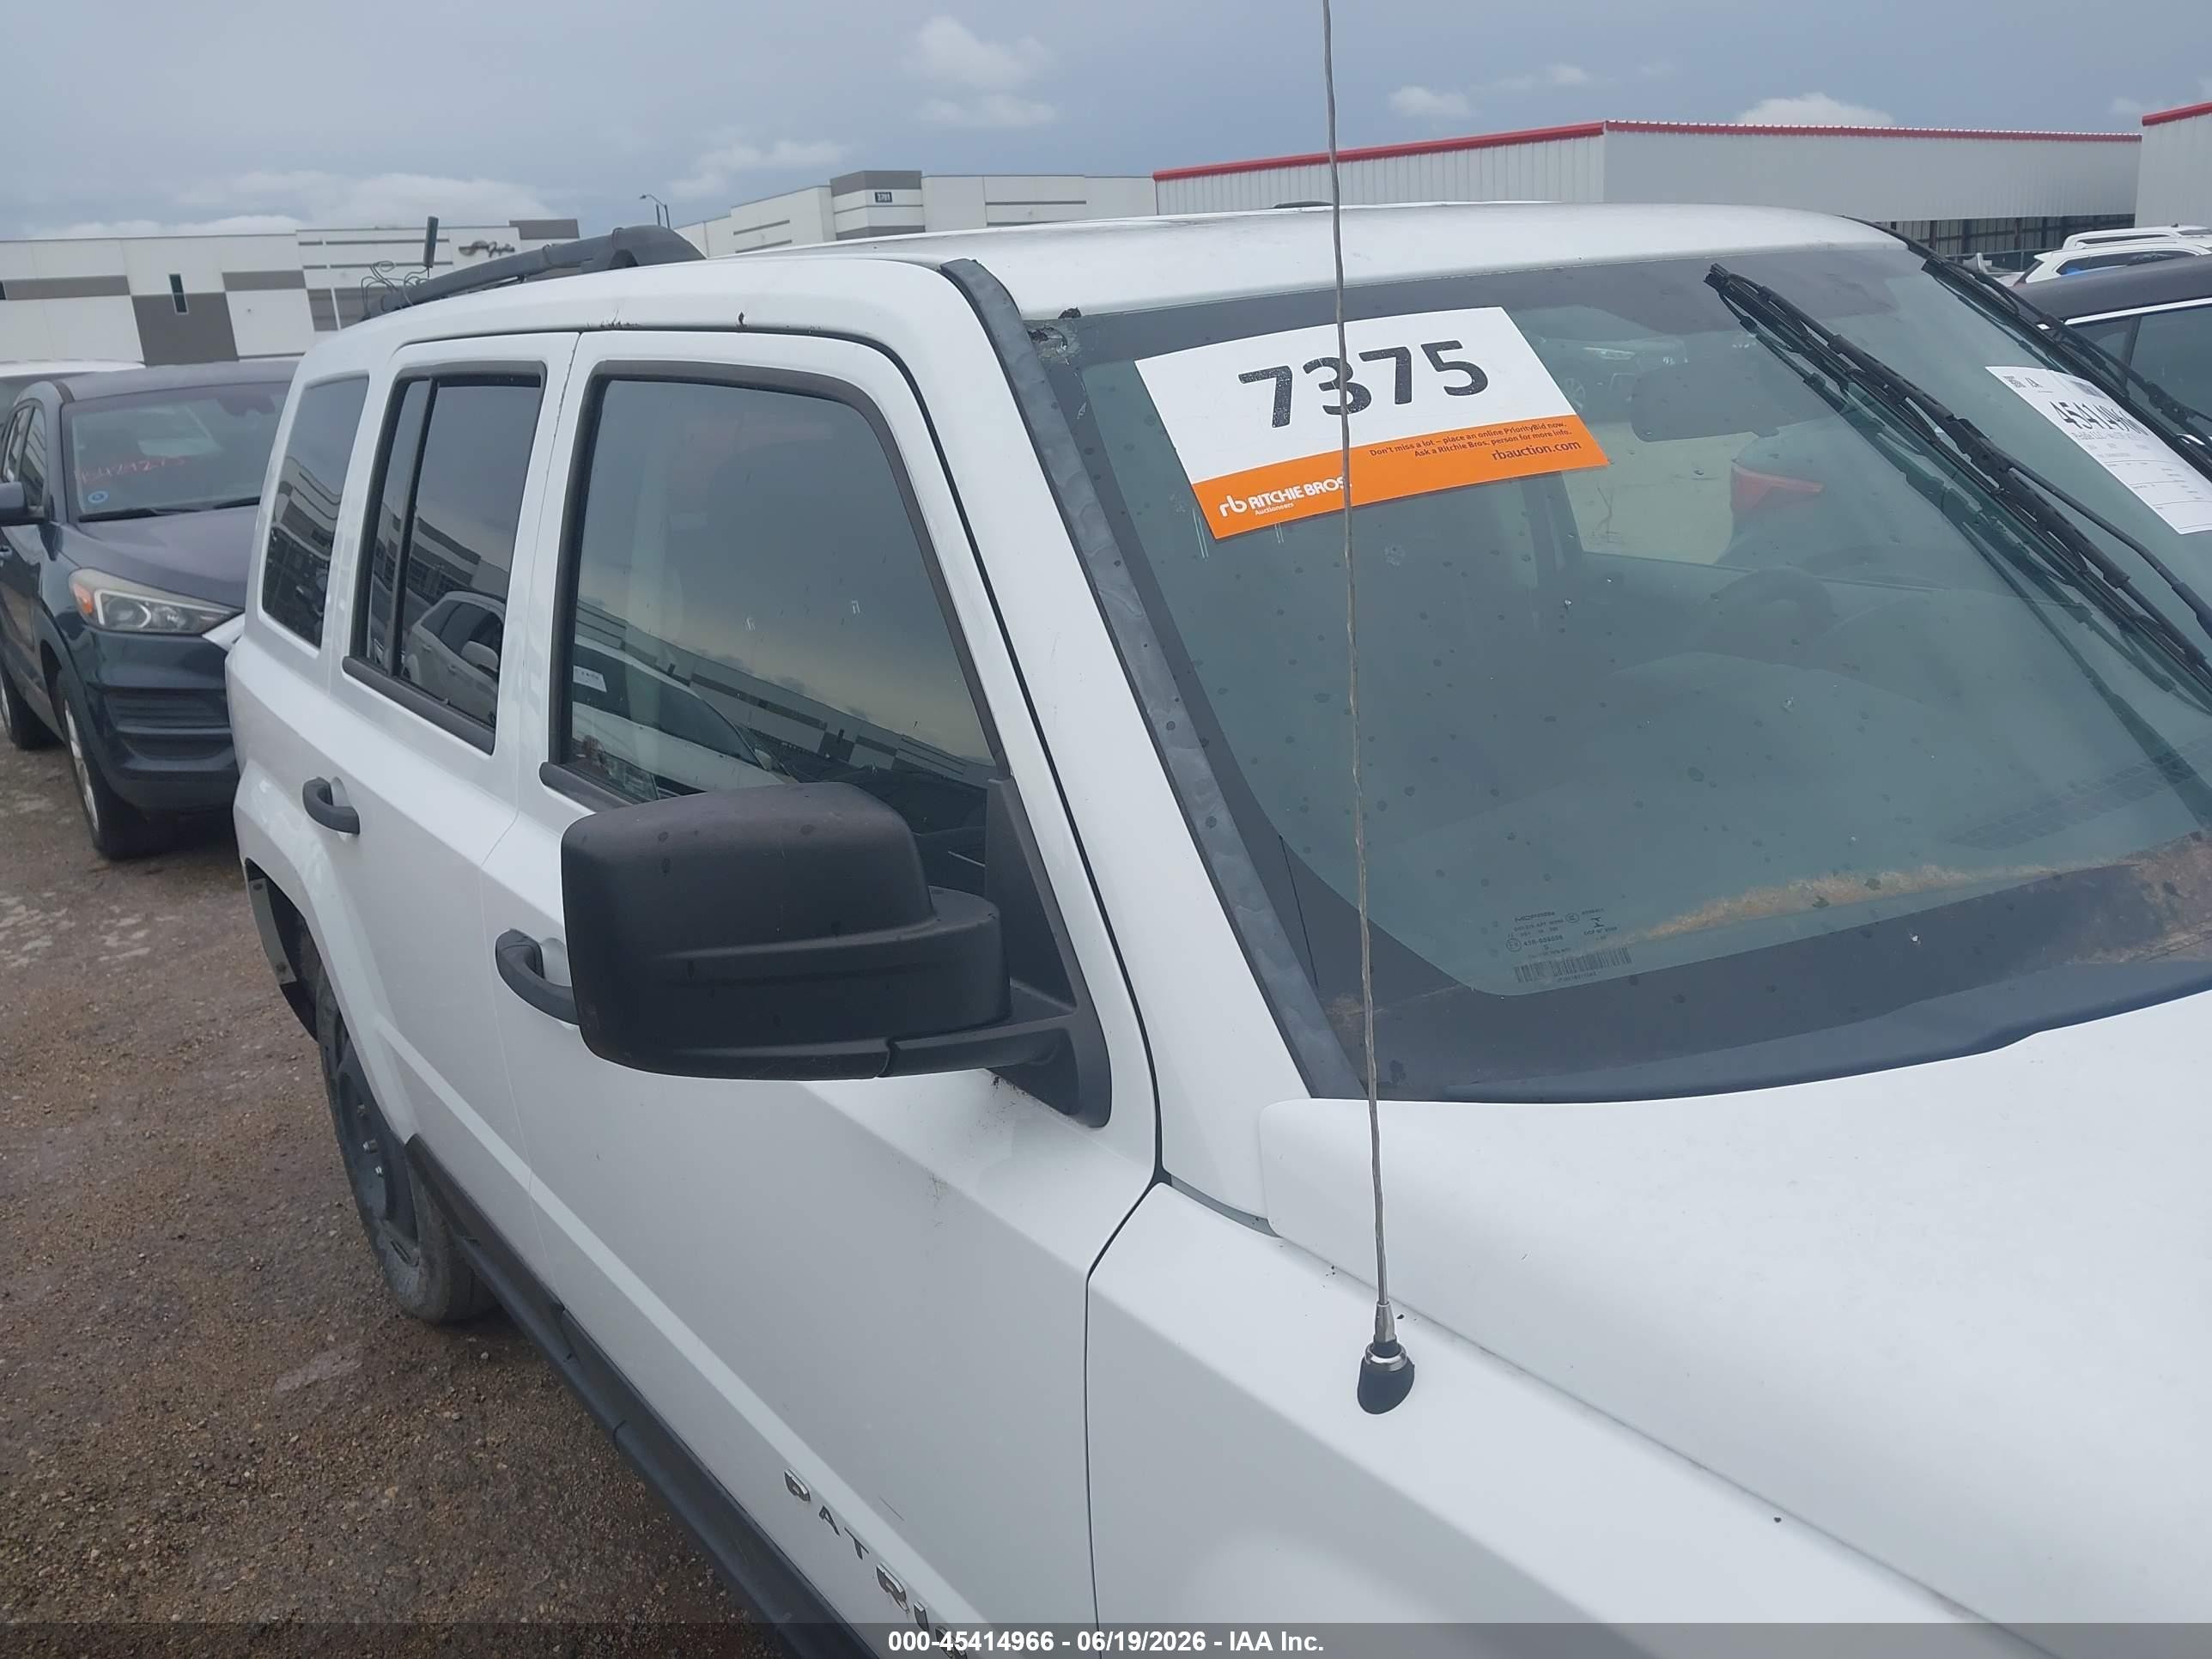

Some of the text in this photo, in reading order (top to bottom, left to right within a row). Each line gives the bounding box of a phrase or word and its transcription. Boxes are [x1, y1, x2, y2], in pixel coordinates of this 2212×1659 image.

[1237, 340, 1489, 428] 7375
[1370, 446, 1395, 457] Don't
[1395, 442, 1415, 453] miss
[1423, 439, 1435, 447] lot
[1443, 434, 1465, 445] place
[1478, 428, 1503, 439] online
[1504, 423, 1547, 436] PriorityBid
[1414, 448, 1431, 457] Ask
[1438, 441, 1468, 453] Ritchie
[1468, 439, 1491, 448] Bros.
[1491, 434, 1519, 447] person
[1492, 441, 1582, 461] rbauction.com
[1248, 485, 1305, 509] RITCHIE
[1255, 502, 1295, 516] Auctioneers
